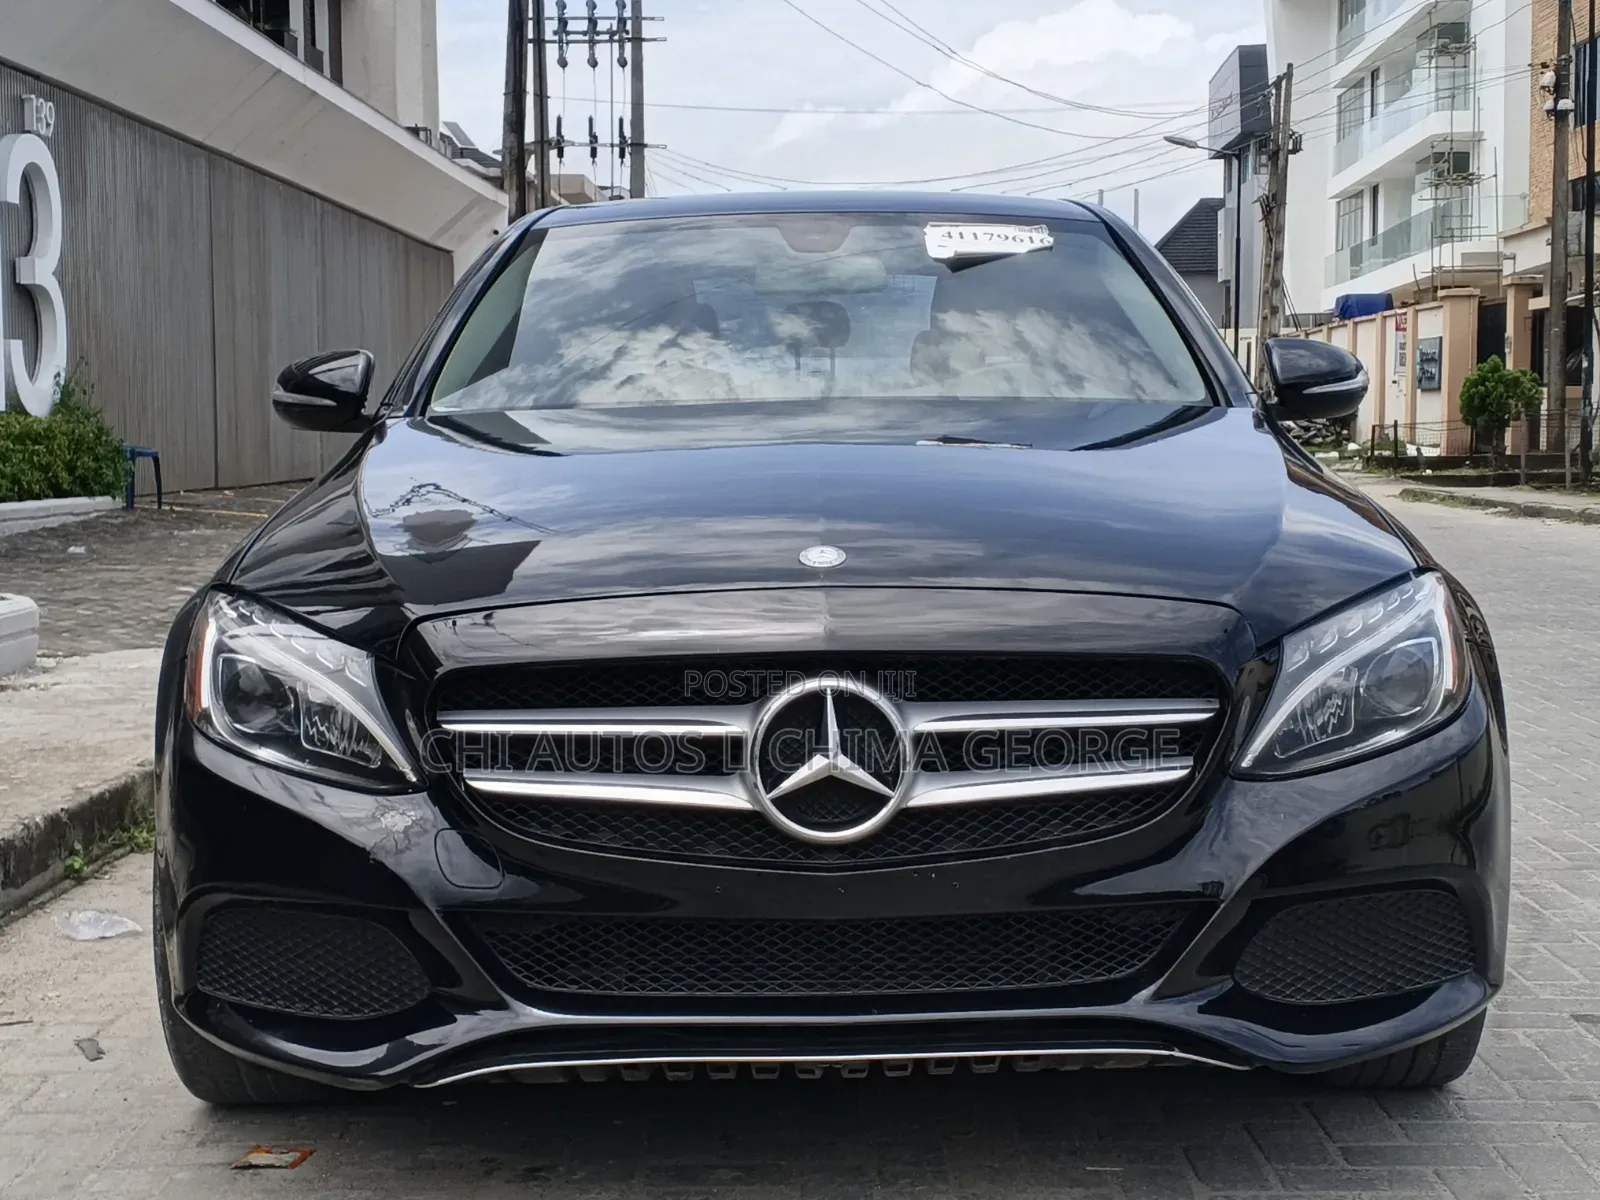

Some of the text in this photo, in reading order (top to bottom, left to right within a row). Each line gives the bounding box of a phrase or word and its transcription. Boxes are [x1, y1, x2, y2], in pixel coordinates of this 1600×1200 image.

[21, 94, 55, 138] 139
[941, 231, 1052, 246] 41179616
[0, 133, 67, 418] 3
